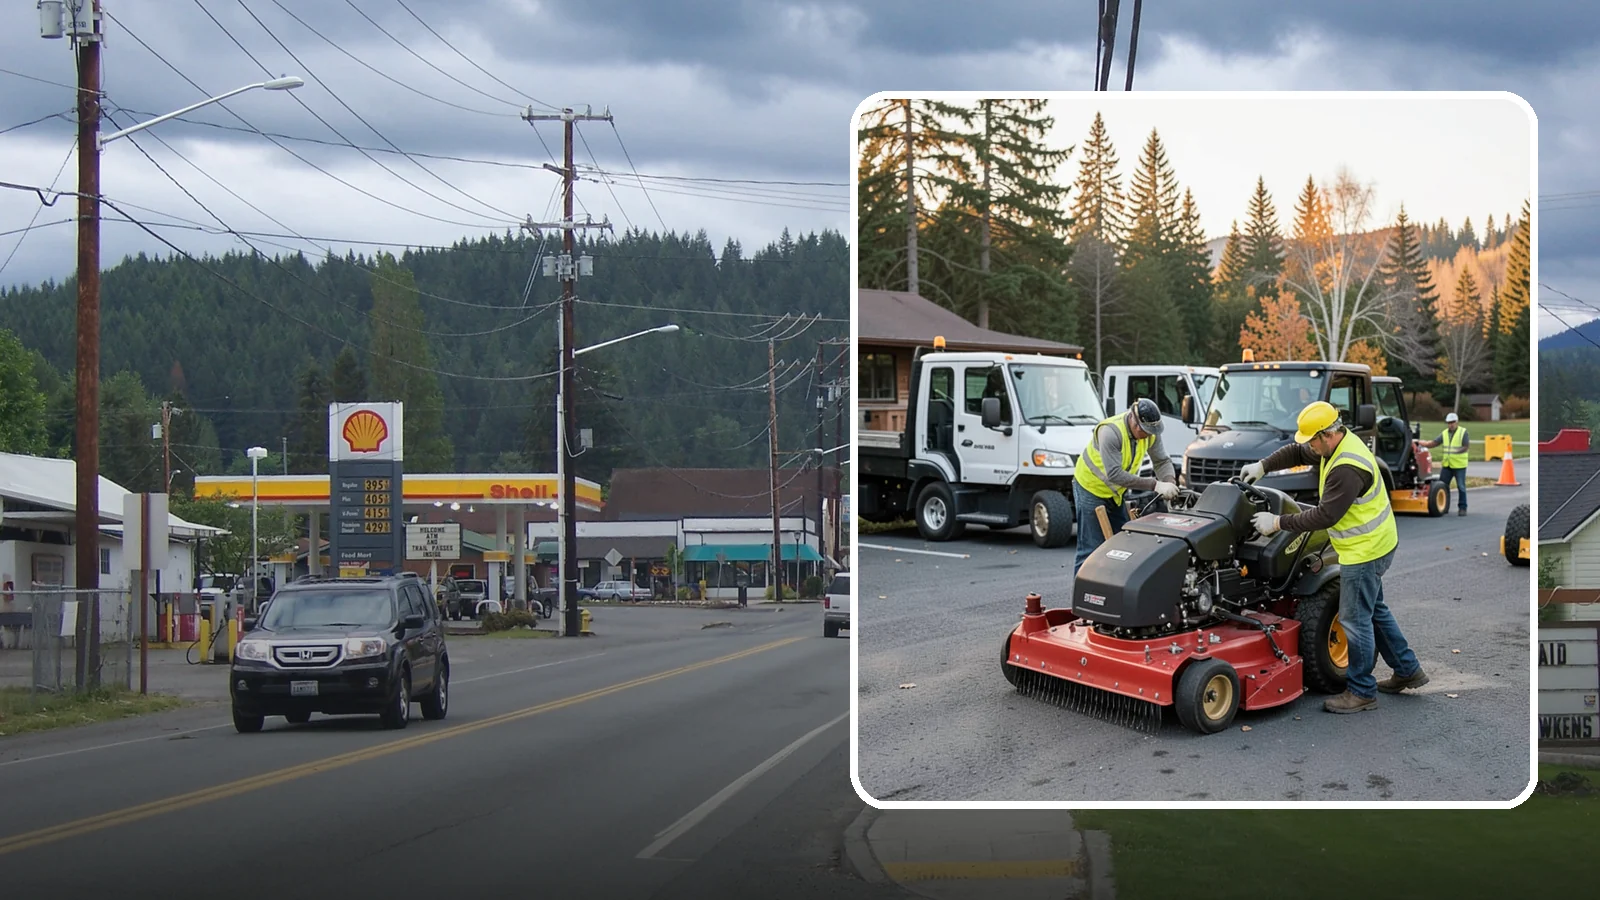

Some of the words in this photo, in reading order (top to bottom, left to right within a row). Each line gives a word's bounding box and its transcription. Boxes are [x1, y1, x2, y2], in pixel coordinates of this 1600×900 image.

[366, 480, 384, 490] 395
[490, 484, 548, 499] Shell
[366, 494, 384, 504] 405
[366, 508, 384, 518] 415
[366, 522, 384, 533] 429
[1538, 643, 1567, 665] AID
